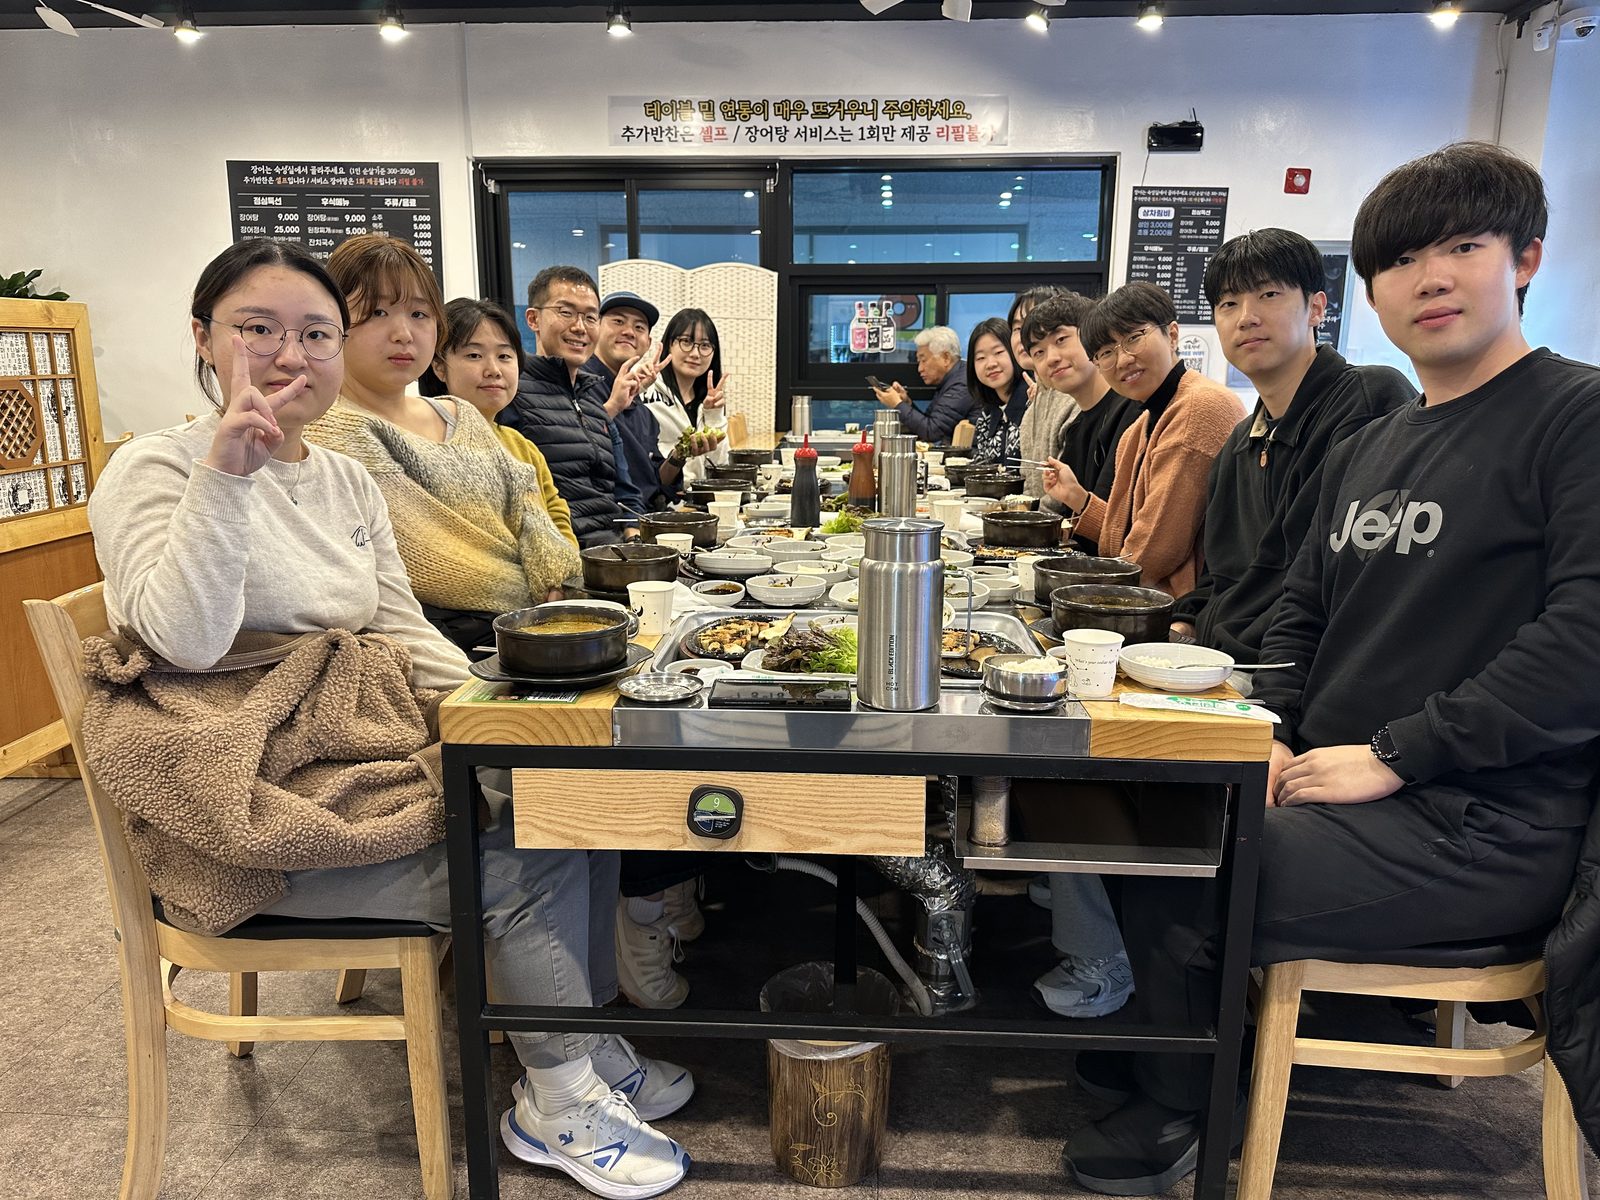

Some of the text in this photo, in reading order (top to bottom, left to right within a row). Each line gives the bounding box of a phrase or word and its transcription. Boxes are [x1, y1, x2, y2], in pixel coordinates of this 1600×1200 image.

[644, 99, 695, 121] 테이블
[720, 99, 769, 122] 연통이
[773, 99, 809, 121] 매우
[811, 99, 878, 121] 뜨거우니
[882, 99, 972, 121] 주의하세요.
[621, 126, 694, 142] 추가반찬은
[700, 125, 728, 143] 셀프
[733, 125, 740, 143] /
[745, 125, 789, 142] 장어탕
[794, 125, 853, 142] 서비스는
[858, 125, 896, 142] 1회만
[901, 125, 931, 142] 제공
[251, 165, 272, 175] 장어는
[278, 213, 299, 222] 9,000
[274, 226, 300, 234] 25,000
[888, 634, 898, 675] BLACK EDITION
[714, 797, 720, 808] 9
